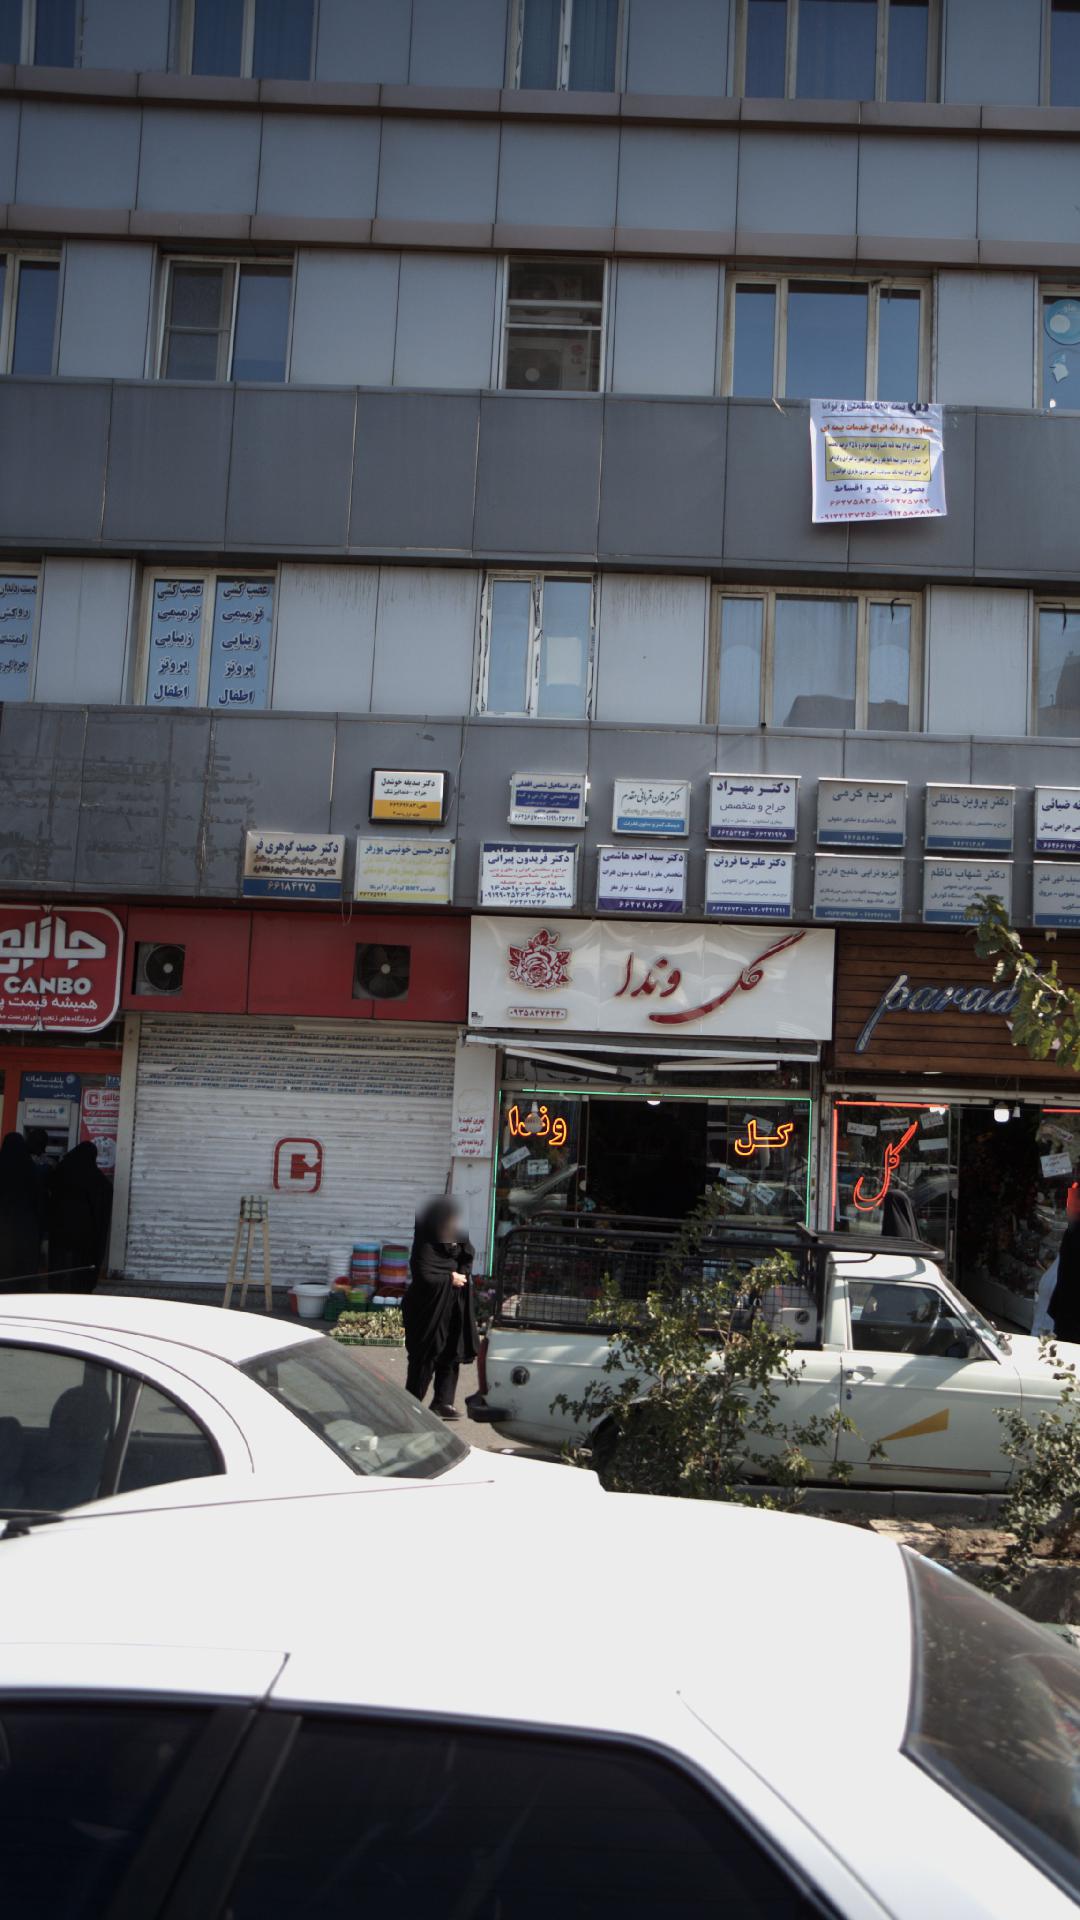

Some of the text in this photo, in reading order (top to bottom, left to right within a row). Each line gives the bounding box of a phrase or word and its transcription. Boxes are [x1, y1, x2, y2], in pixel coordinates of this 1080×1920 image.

[846, 423, 869, 432] خدمات
[870, 423, 887, 433] انواع
[156, 581, 203, 599] عصب کشی
[222, 582, 269, 599] عصب کشی
[157, 606, 200, 622] ترمیمی
[221, 606, 264, 623] ترمیمی
[154, 629, 194, 648] زیبایی
[221, 631, 261, 650] زیبایی
[157, 657, 189, 676] پروتز
[223, 660, 255, 678] پروتز
[153, 684, 189, 701] اطفال
[218, 688, 255, 705] اطفال
[422, 779, 436, 788] دکتر
[716, 780, 791, 796] دکتر مهراد
[866, 791, 893, 803] مریم
[991, 796, 1009, 810] دکتر
[1041, 797, 1070, 812] ضیائی
[719, 801, 786, 815] جراح و متخصص
[253, 838, 264, 854] فر
[296, 842, 318, 855] حمید
[319, 840, 339, 856] دکتر
[433, 846, 450, 856] دکتر
[516, 853, 548, 864] فریدون
[551, 854, 570, 865] دکتر
[602, 851, 630, 862] هاشمی
[649, 853, 663, 862] سید
[666, 853, 684, 864] دکتر
[713, 855, 786, 870] دکتر علیرضا فروتن
[818, 867, 838, 877] فارس
[839, 867, 858, 878] خلیج
[955, 869, 982, 880] شهاب
[984, 870, 1006, 881] دکتر
[664, 886, 674, 894] نوار
[615, 952, 682, 998] وندا
[3, 975, 92, 995] CANBO
[8, 995, 48, 1010] قیمت
[51, 996, 98, 1012] همیشه
